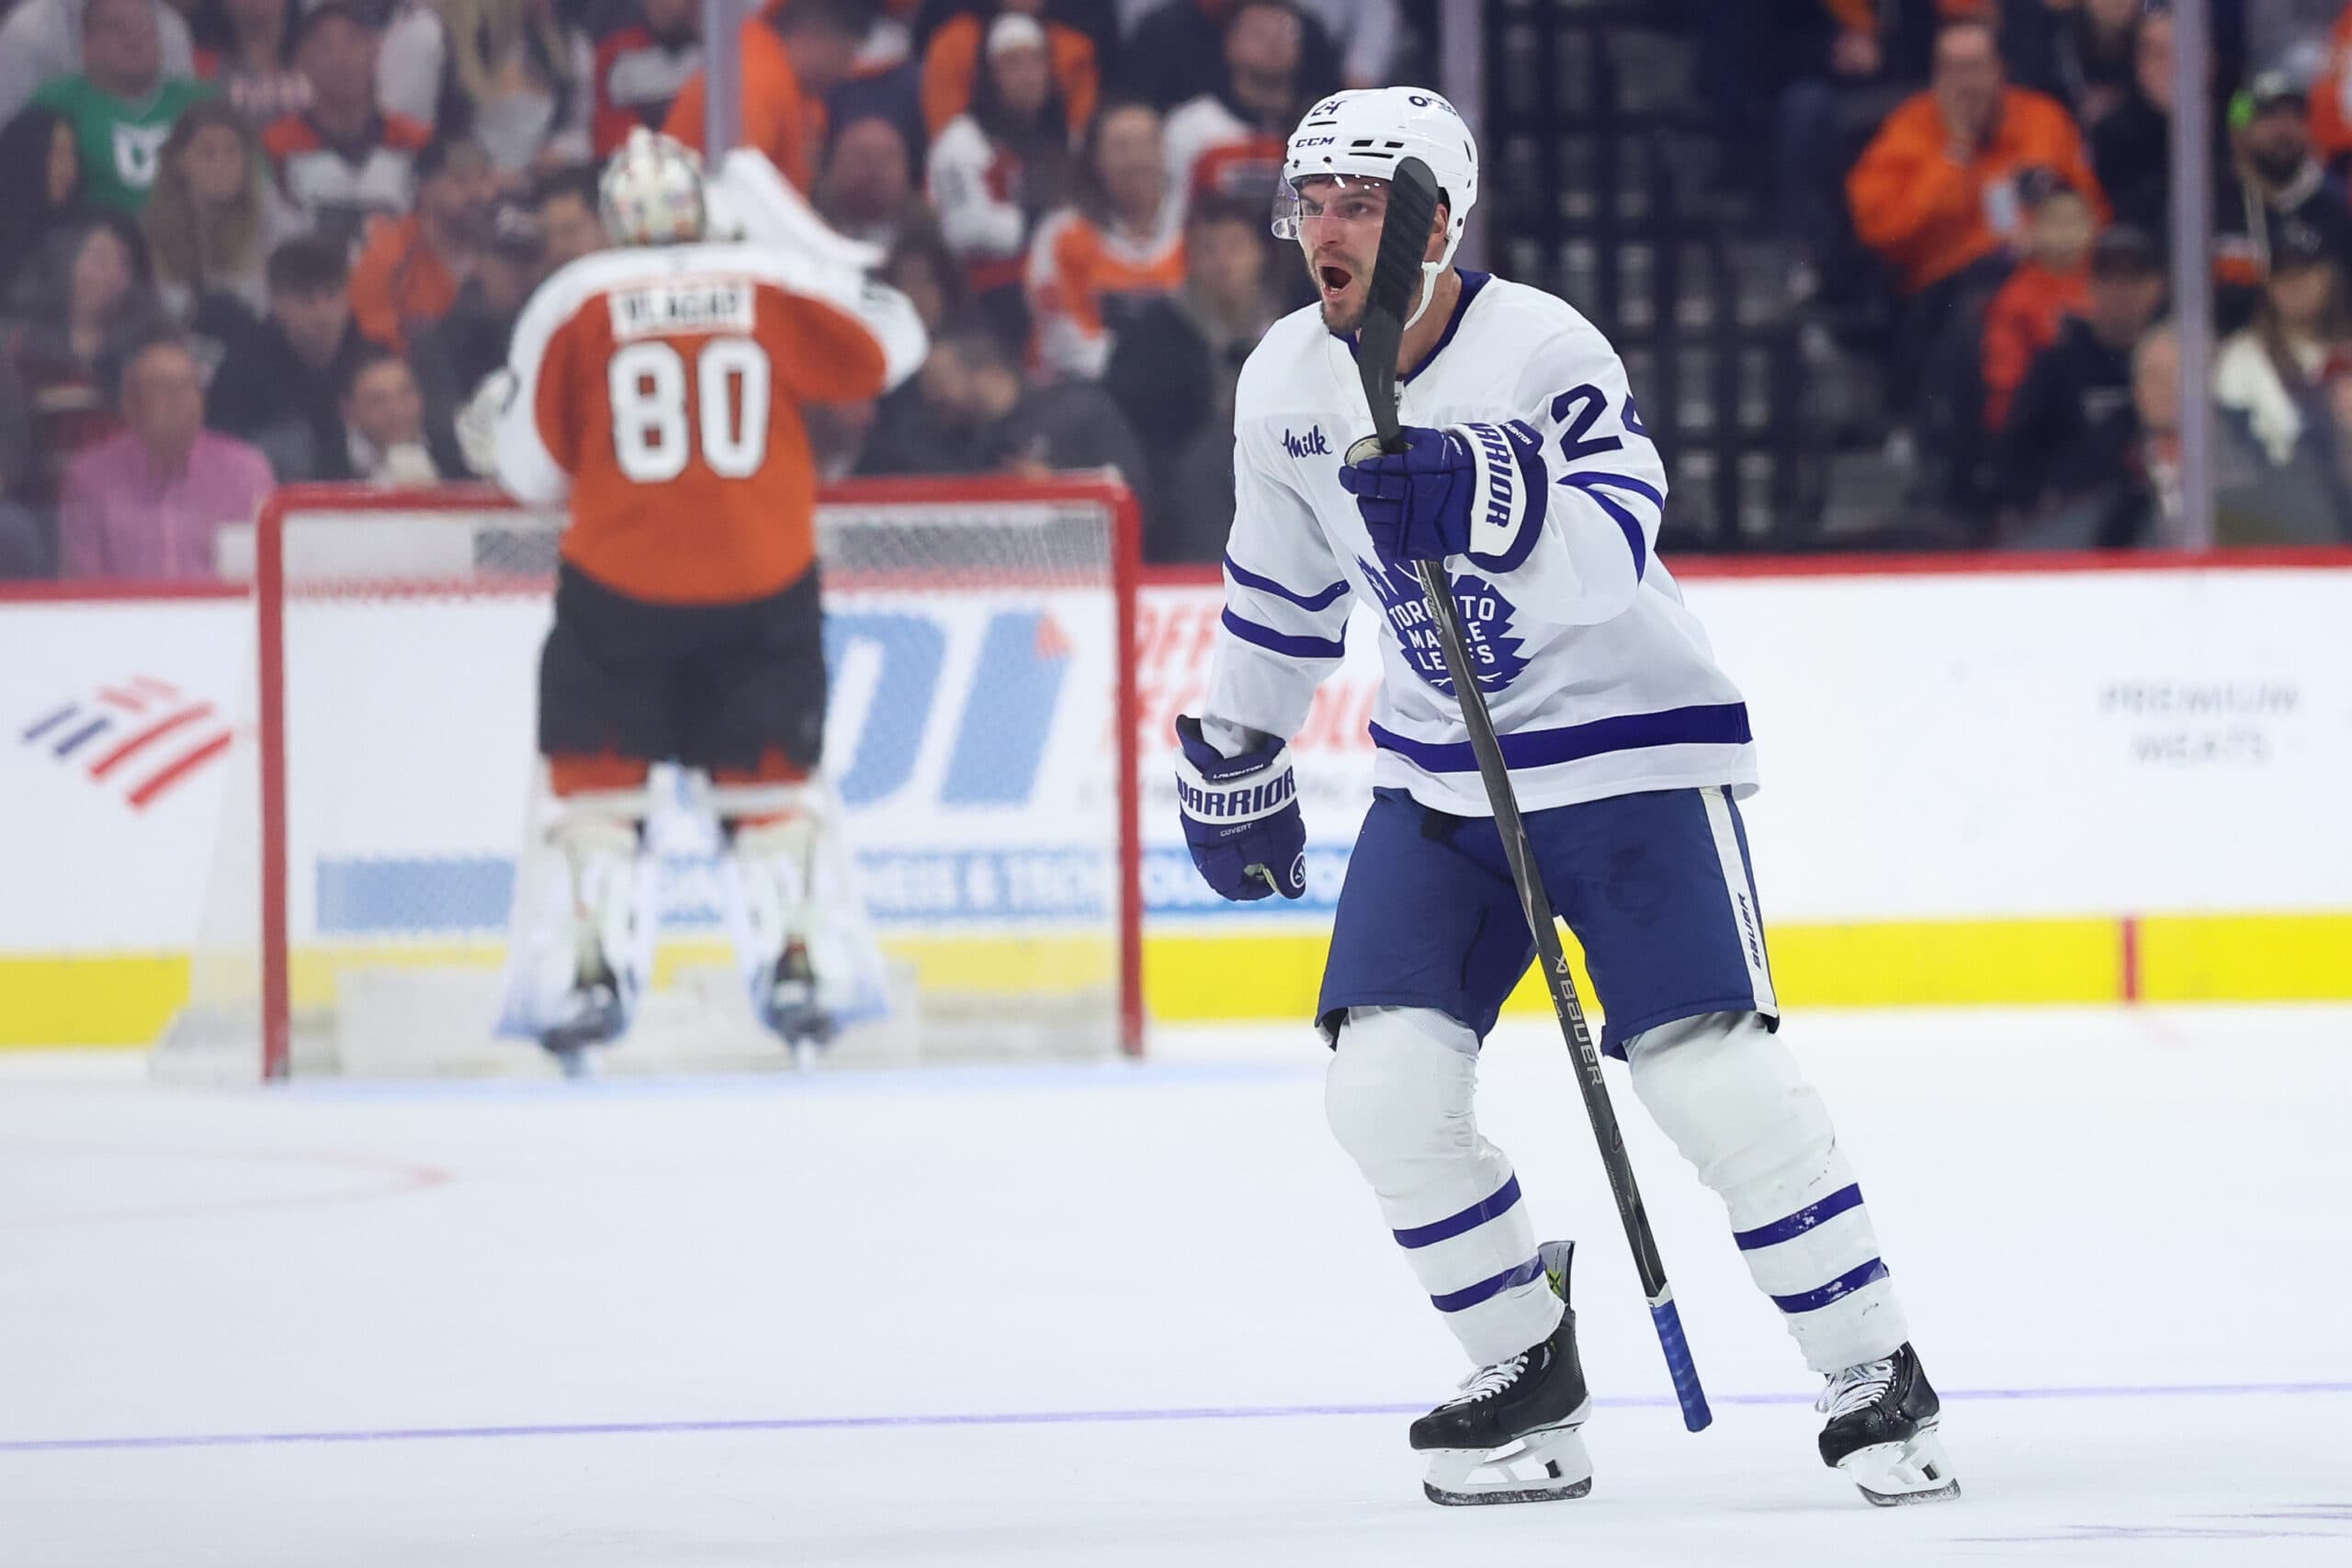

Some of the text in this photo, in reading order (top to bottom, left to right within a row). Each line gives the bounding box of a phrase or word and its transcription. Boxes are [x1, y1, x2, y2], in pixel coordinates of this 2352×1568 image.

[1295, 137, 1336, 148] CCM
[607, 336, 771, 484] 80
[1280, 424, 1333, 459] Milk
[1220, 823, 1253, 837] COVERT
[1737, 892, 1761, 970] BAUER
[1560, 979, 1603, 1086] BAUER
